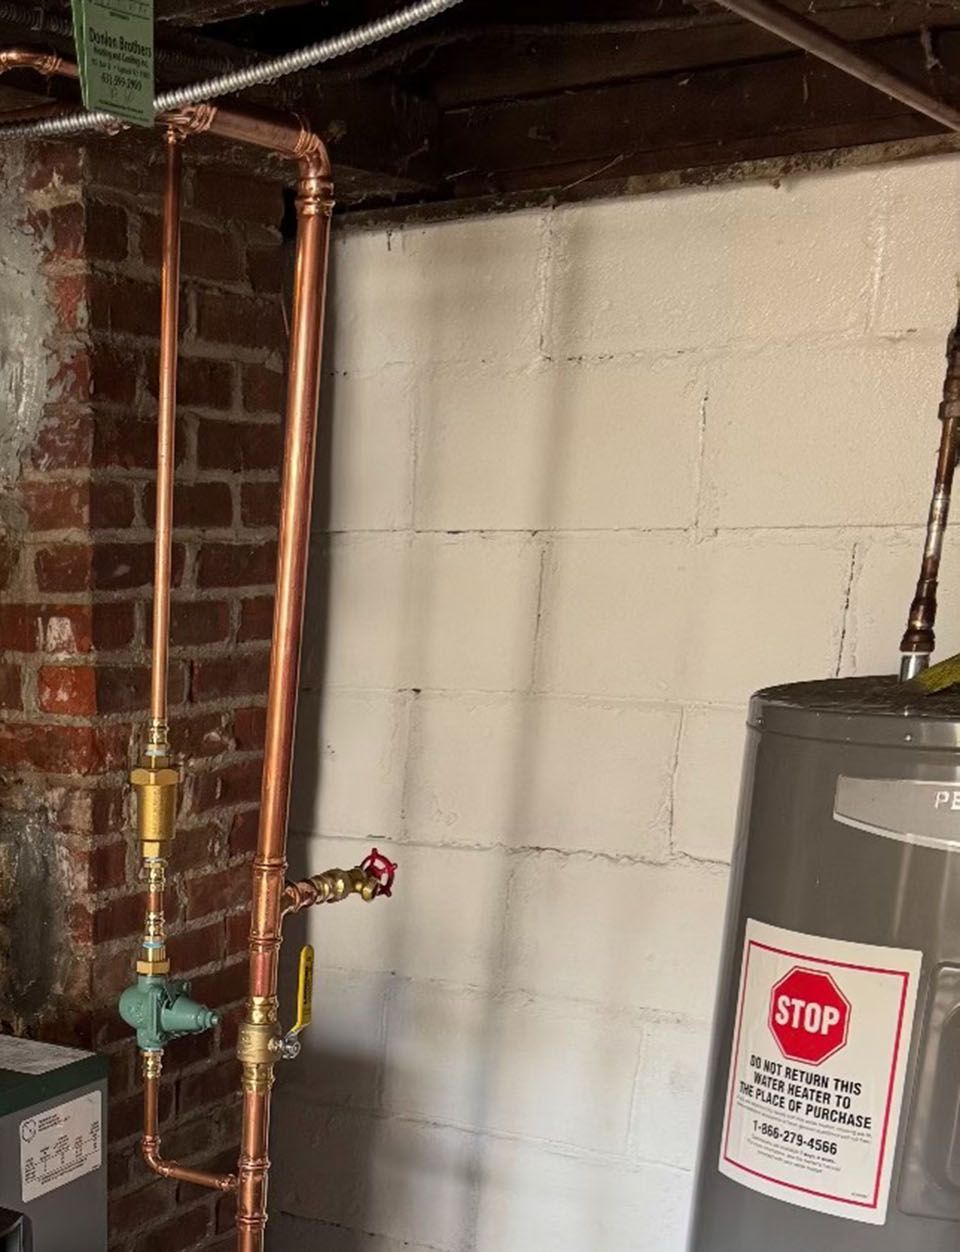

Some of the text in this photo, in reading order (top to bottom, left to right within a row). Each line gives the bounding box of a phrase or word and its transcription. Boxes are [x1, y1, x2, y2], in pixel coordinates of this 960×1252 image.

[120, 36, 152, 58] Brothers
[775, 995, 840, 1035] STOP
[750, 1054, 862, 1096] DO NOT RETURN THIS
[754, 1071, 851, 1109] WATER HEATER TO
[739, 1081, 872, 1129] THE PLACE OF PURCHASE
[753, 1120, 837, 1155] 1-866-279-4566
